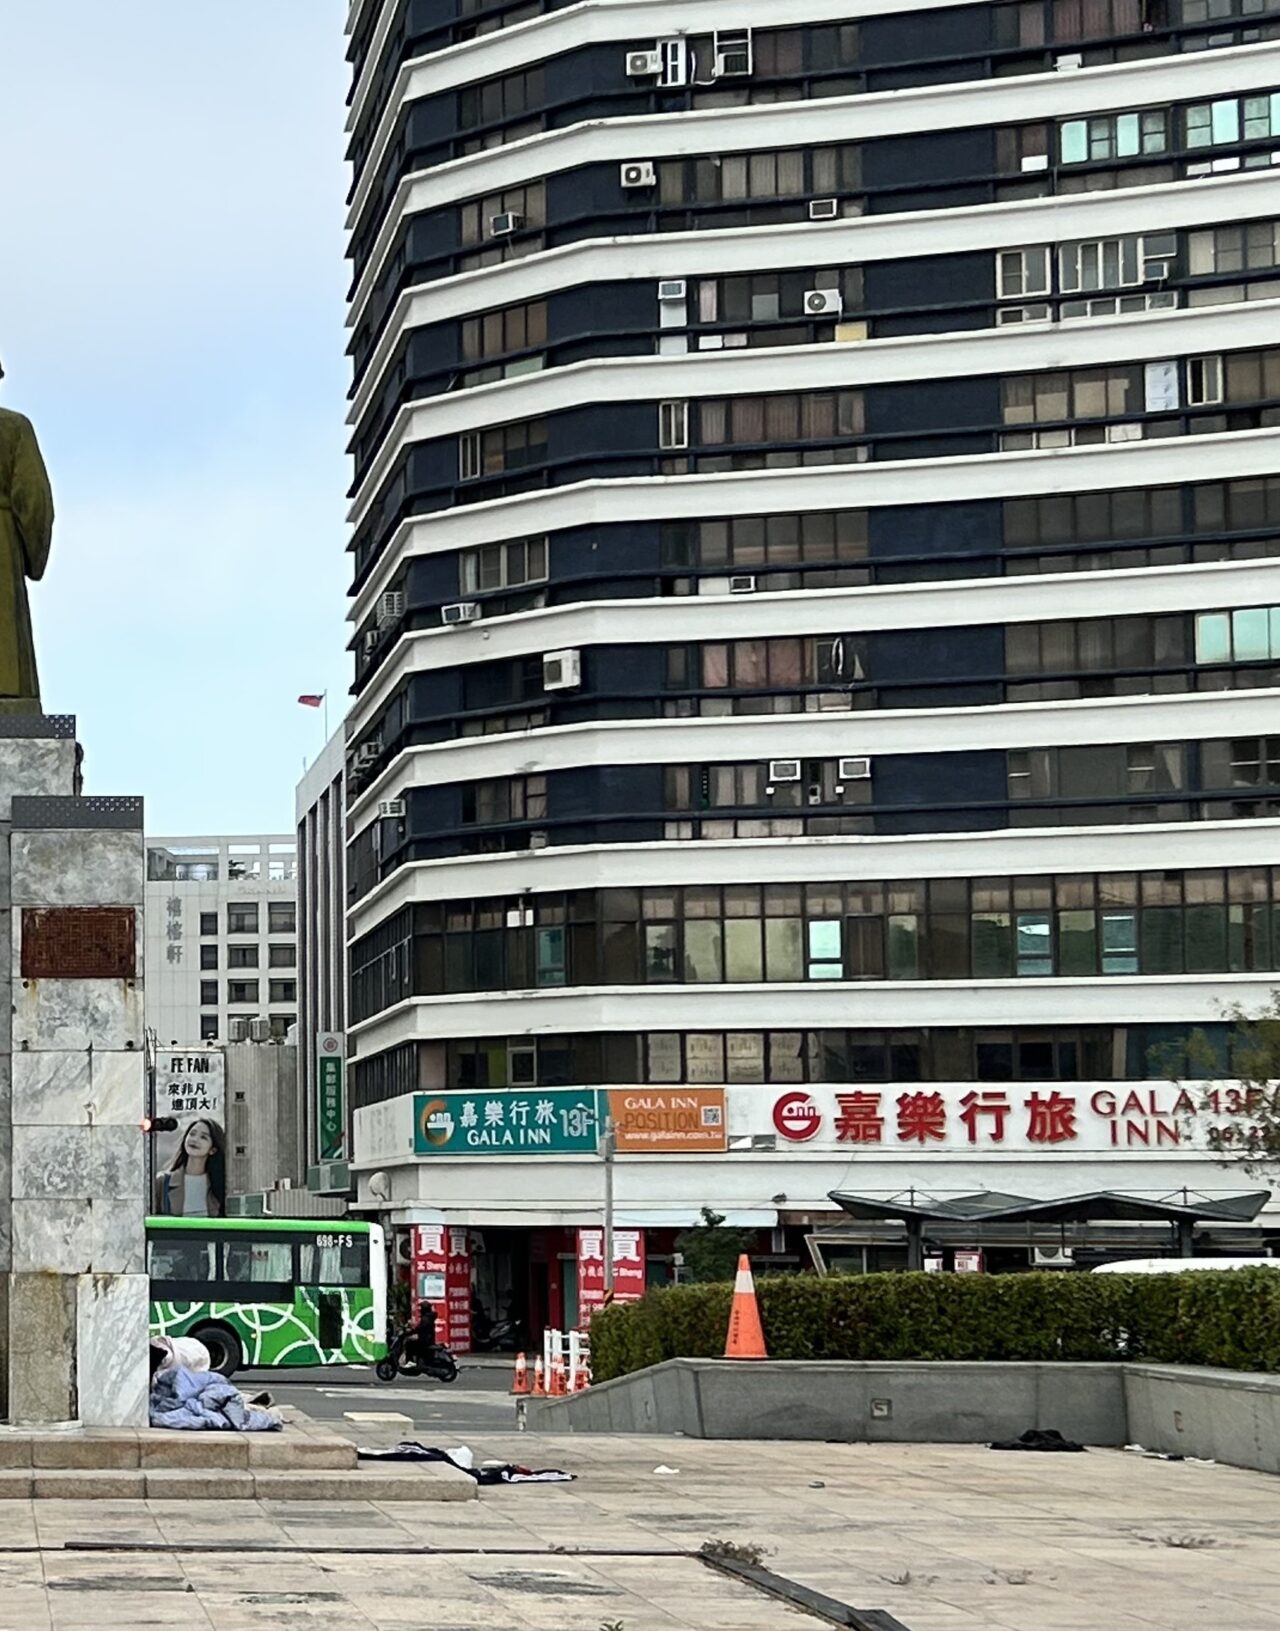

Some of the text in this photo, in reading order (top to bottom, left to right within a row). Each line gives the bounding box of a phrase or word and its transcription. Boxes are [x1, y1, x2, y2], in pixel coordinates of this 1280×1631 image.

[187, 1057, 209, 1073] FAN
[624, 1097, 698, 1110] GALA INN
[1090, 1088, 1197, 1117] GALA
[460, 1100, 557, 1128] 嘉樂行旅
[625, 1112, 699, 1130] POSITION
[834, 1090, 1079, 1144] 嘉樂行旅
[467, 1128, 551, 1146] GALA INN
[1110, 1119, 1180, 1146] INN
